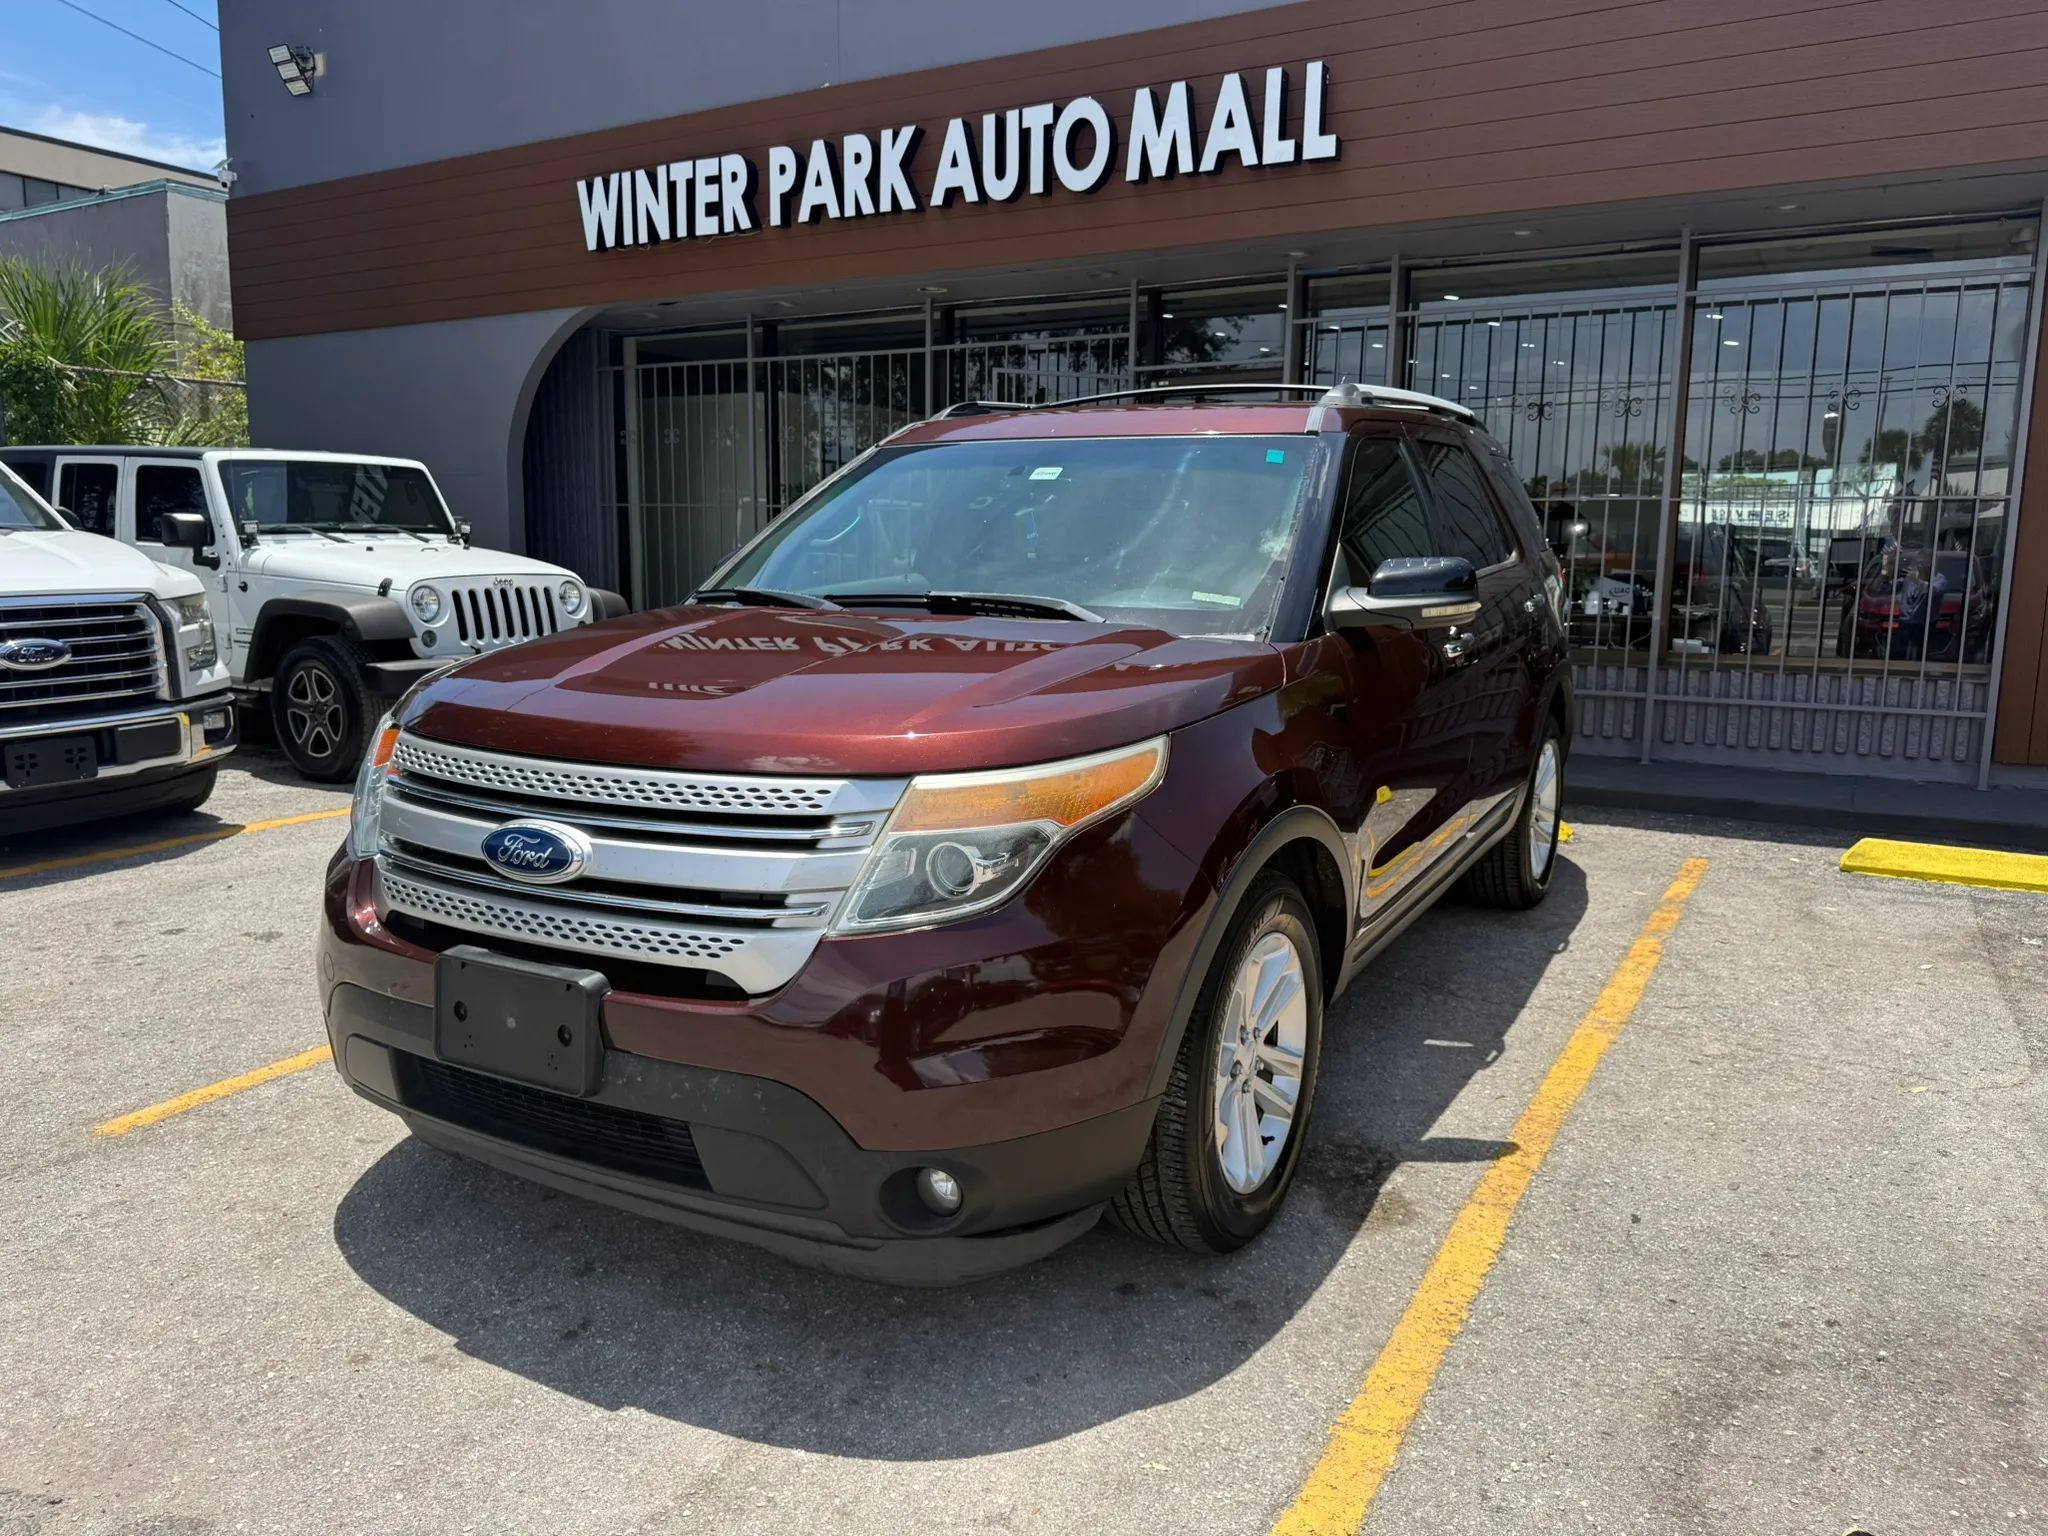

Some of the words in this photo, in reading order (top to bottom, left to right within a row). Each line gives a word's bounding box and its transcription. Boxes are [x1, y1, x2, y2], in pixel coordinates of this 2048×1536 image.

[577, 153, 751, 251] WINTER
[769, 125, 916, 226] PARK
[930, 97, 1110, 206] AUTO
[1125, 60, 1337, 182] MALL
[493, 576, 514, 589] Jeep
[19, 647, 54, 662] Ford
[498, 834, 553, 868] Ford
